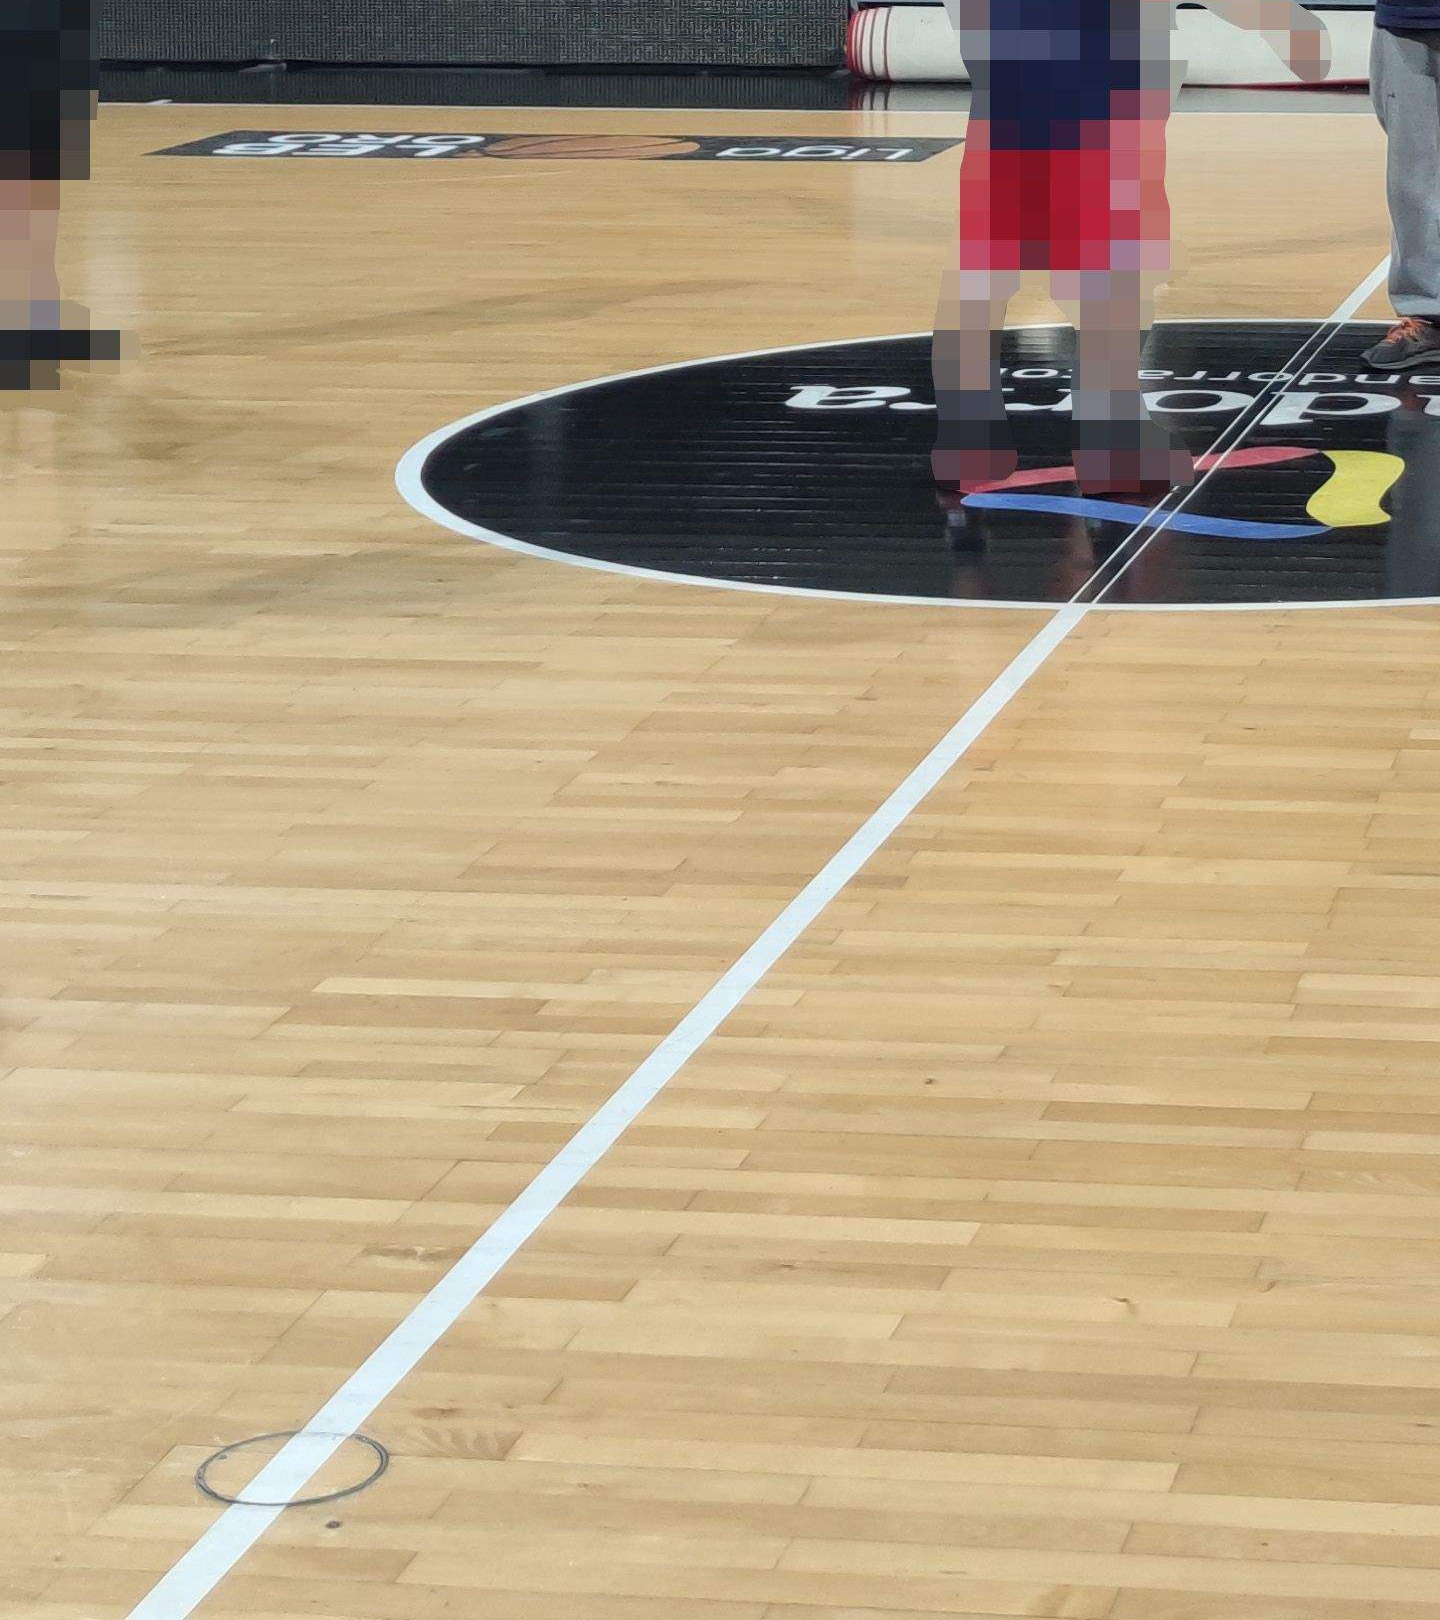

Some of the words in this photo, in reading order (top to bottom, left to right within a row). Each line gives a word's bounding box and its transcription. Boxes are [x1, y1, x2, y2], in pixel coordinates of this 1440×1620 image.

[266, 132, 486, 146] ORO
[212, 142, 462, 157] LEB
[715, 145, 914, 160] Liga
